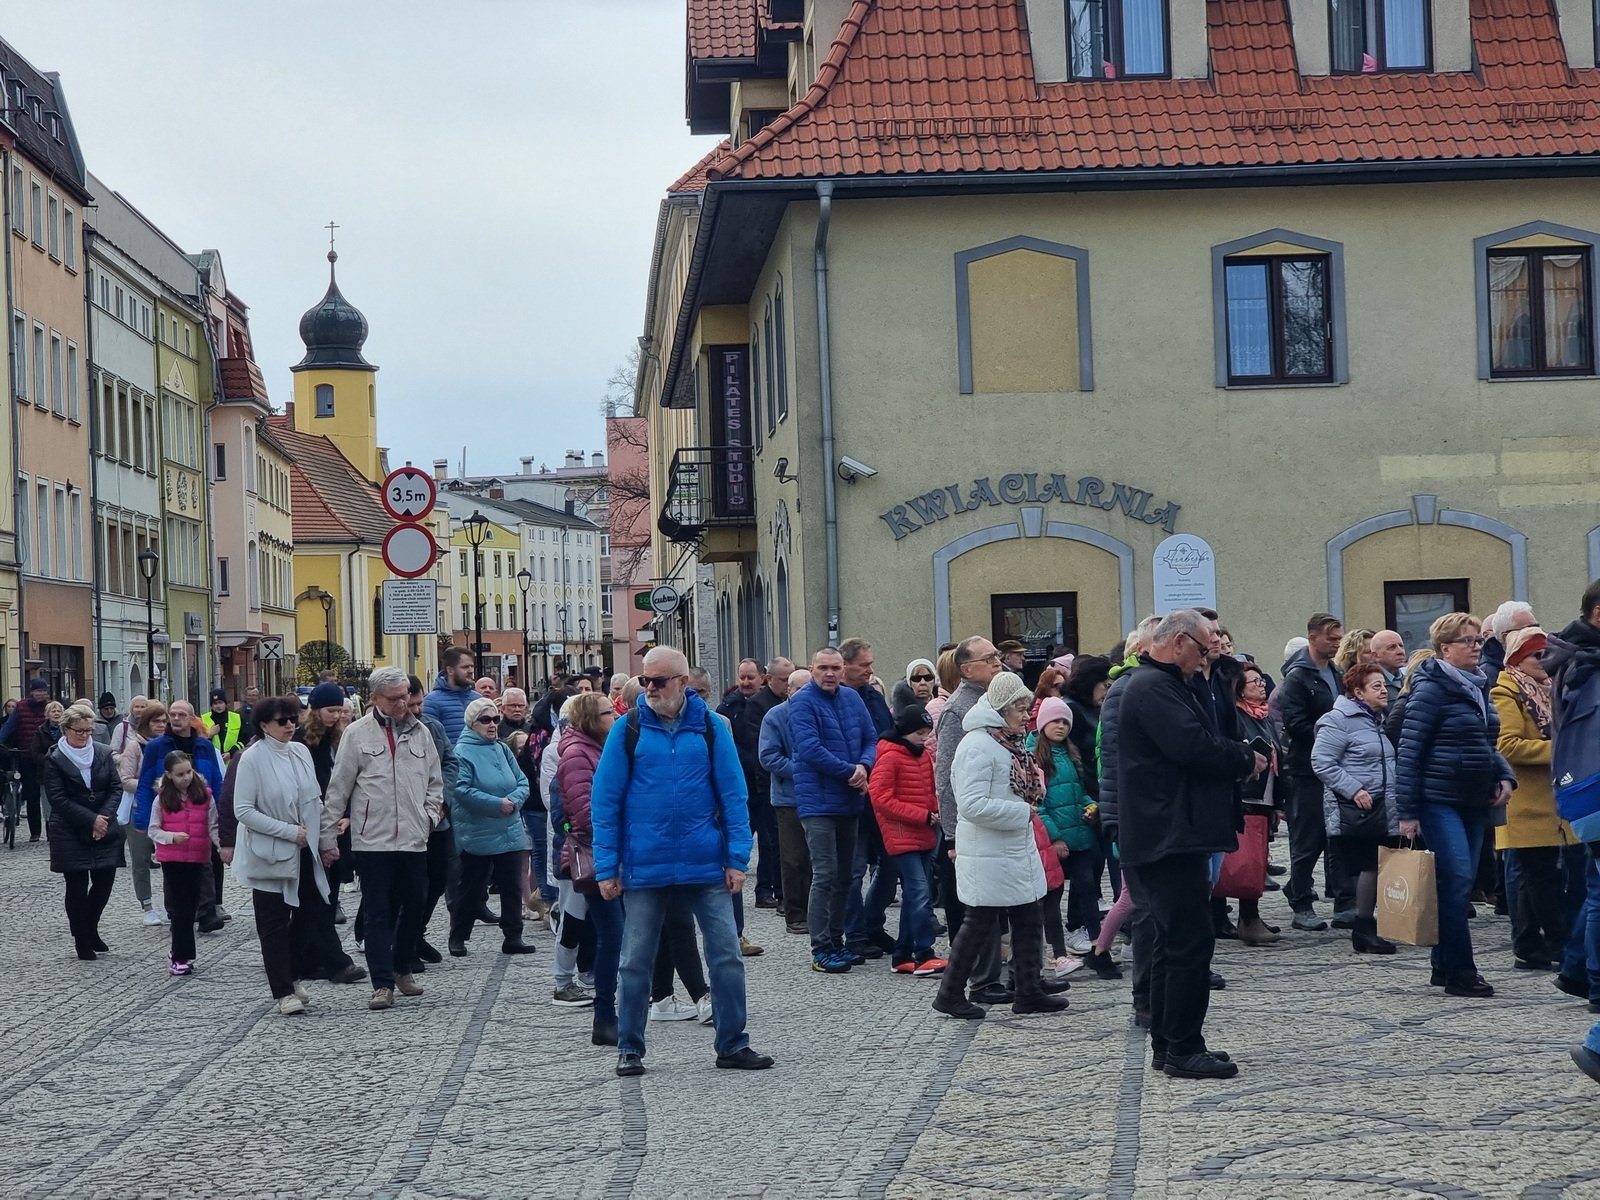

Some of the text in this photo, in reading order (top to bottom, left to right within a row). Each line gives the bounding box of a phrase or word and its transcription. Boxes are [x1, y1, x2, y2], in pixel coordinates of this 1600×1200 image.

[725, 354, 745, 505] PILATES STUDIO
[879, 472, 1181, 541] KWIACIARNIA
